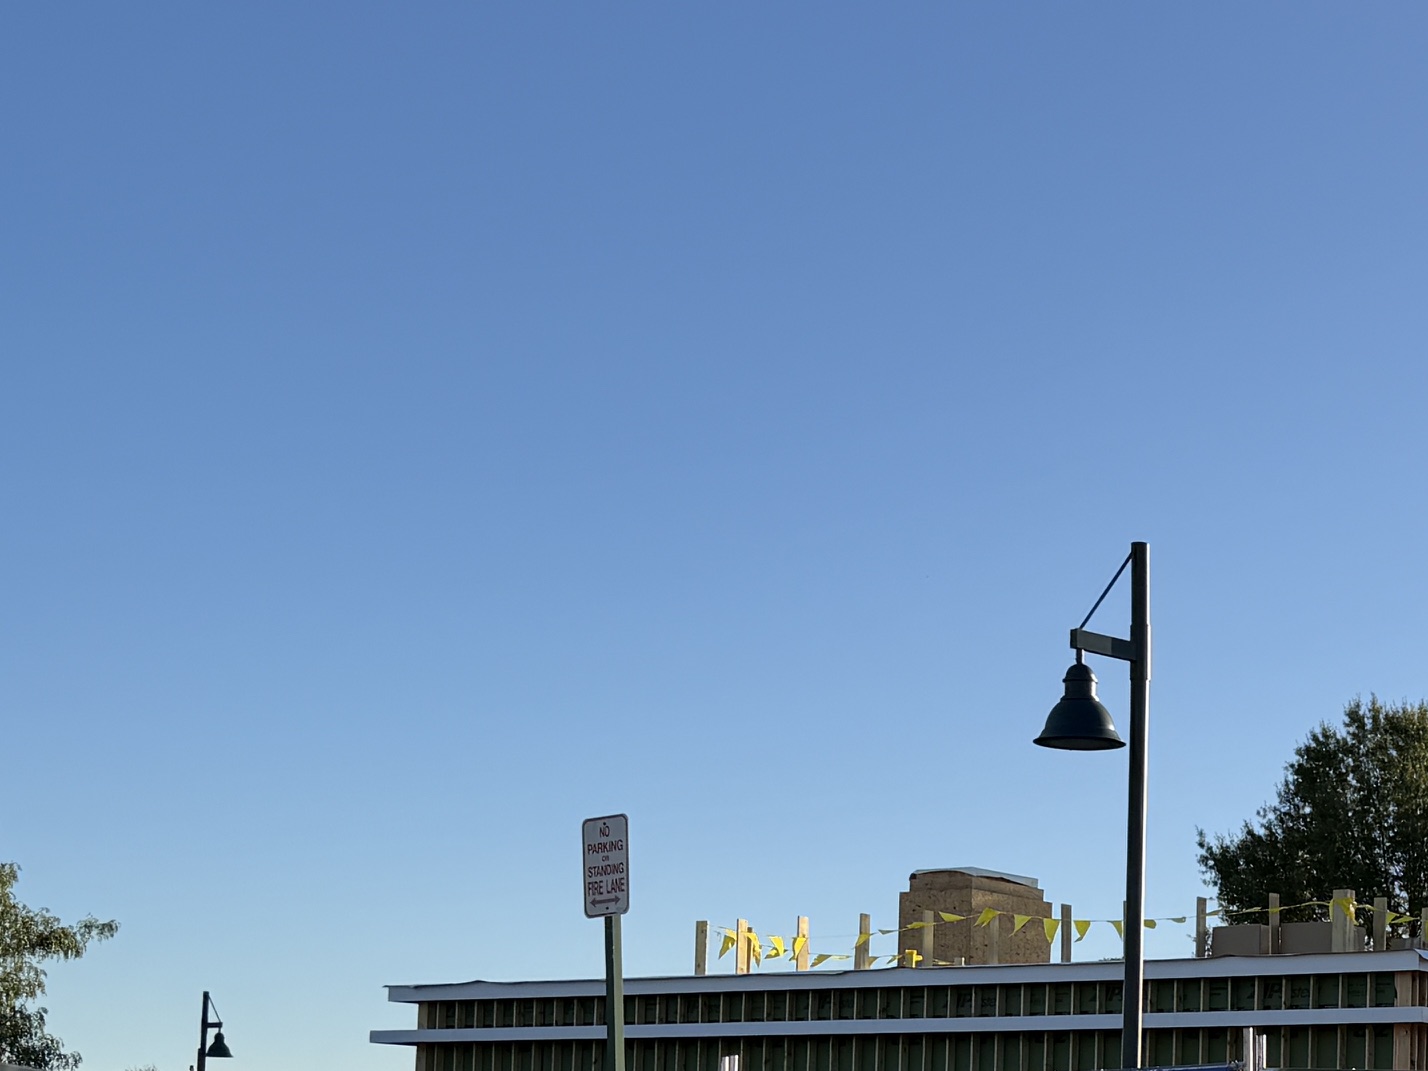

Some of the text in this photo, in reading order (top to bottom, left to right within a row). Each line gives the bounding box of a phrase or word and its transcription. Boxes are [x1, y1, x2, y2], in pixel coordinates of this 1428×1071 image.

[599, 826, 610, 837] NO
[588, 840, 623, 854] PARKING
[588, 862, 624, 878] STANDING
[588, 878, 625, 896] FIRE LANE
